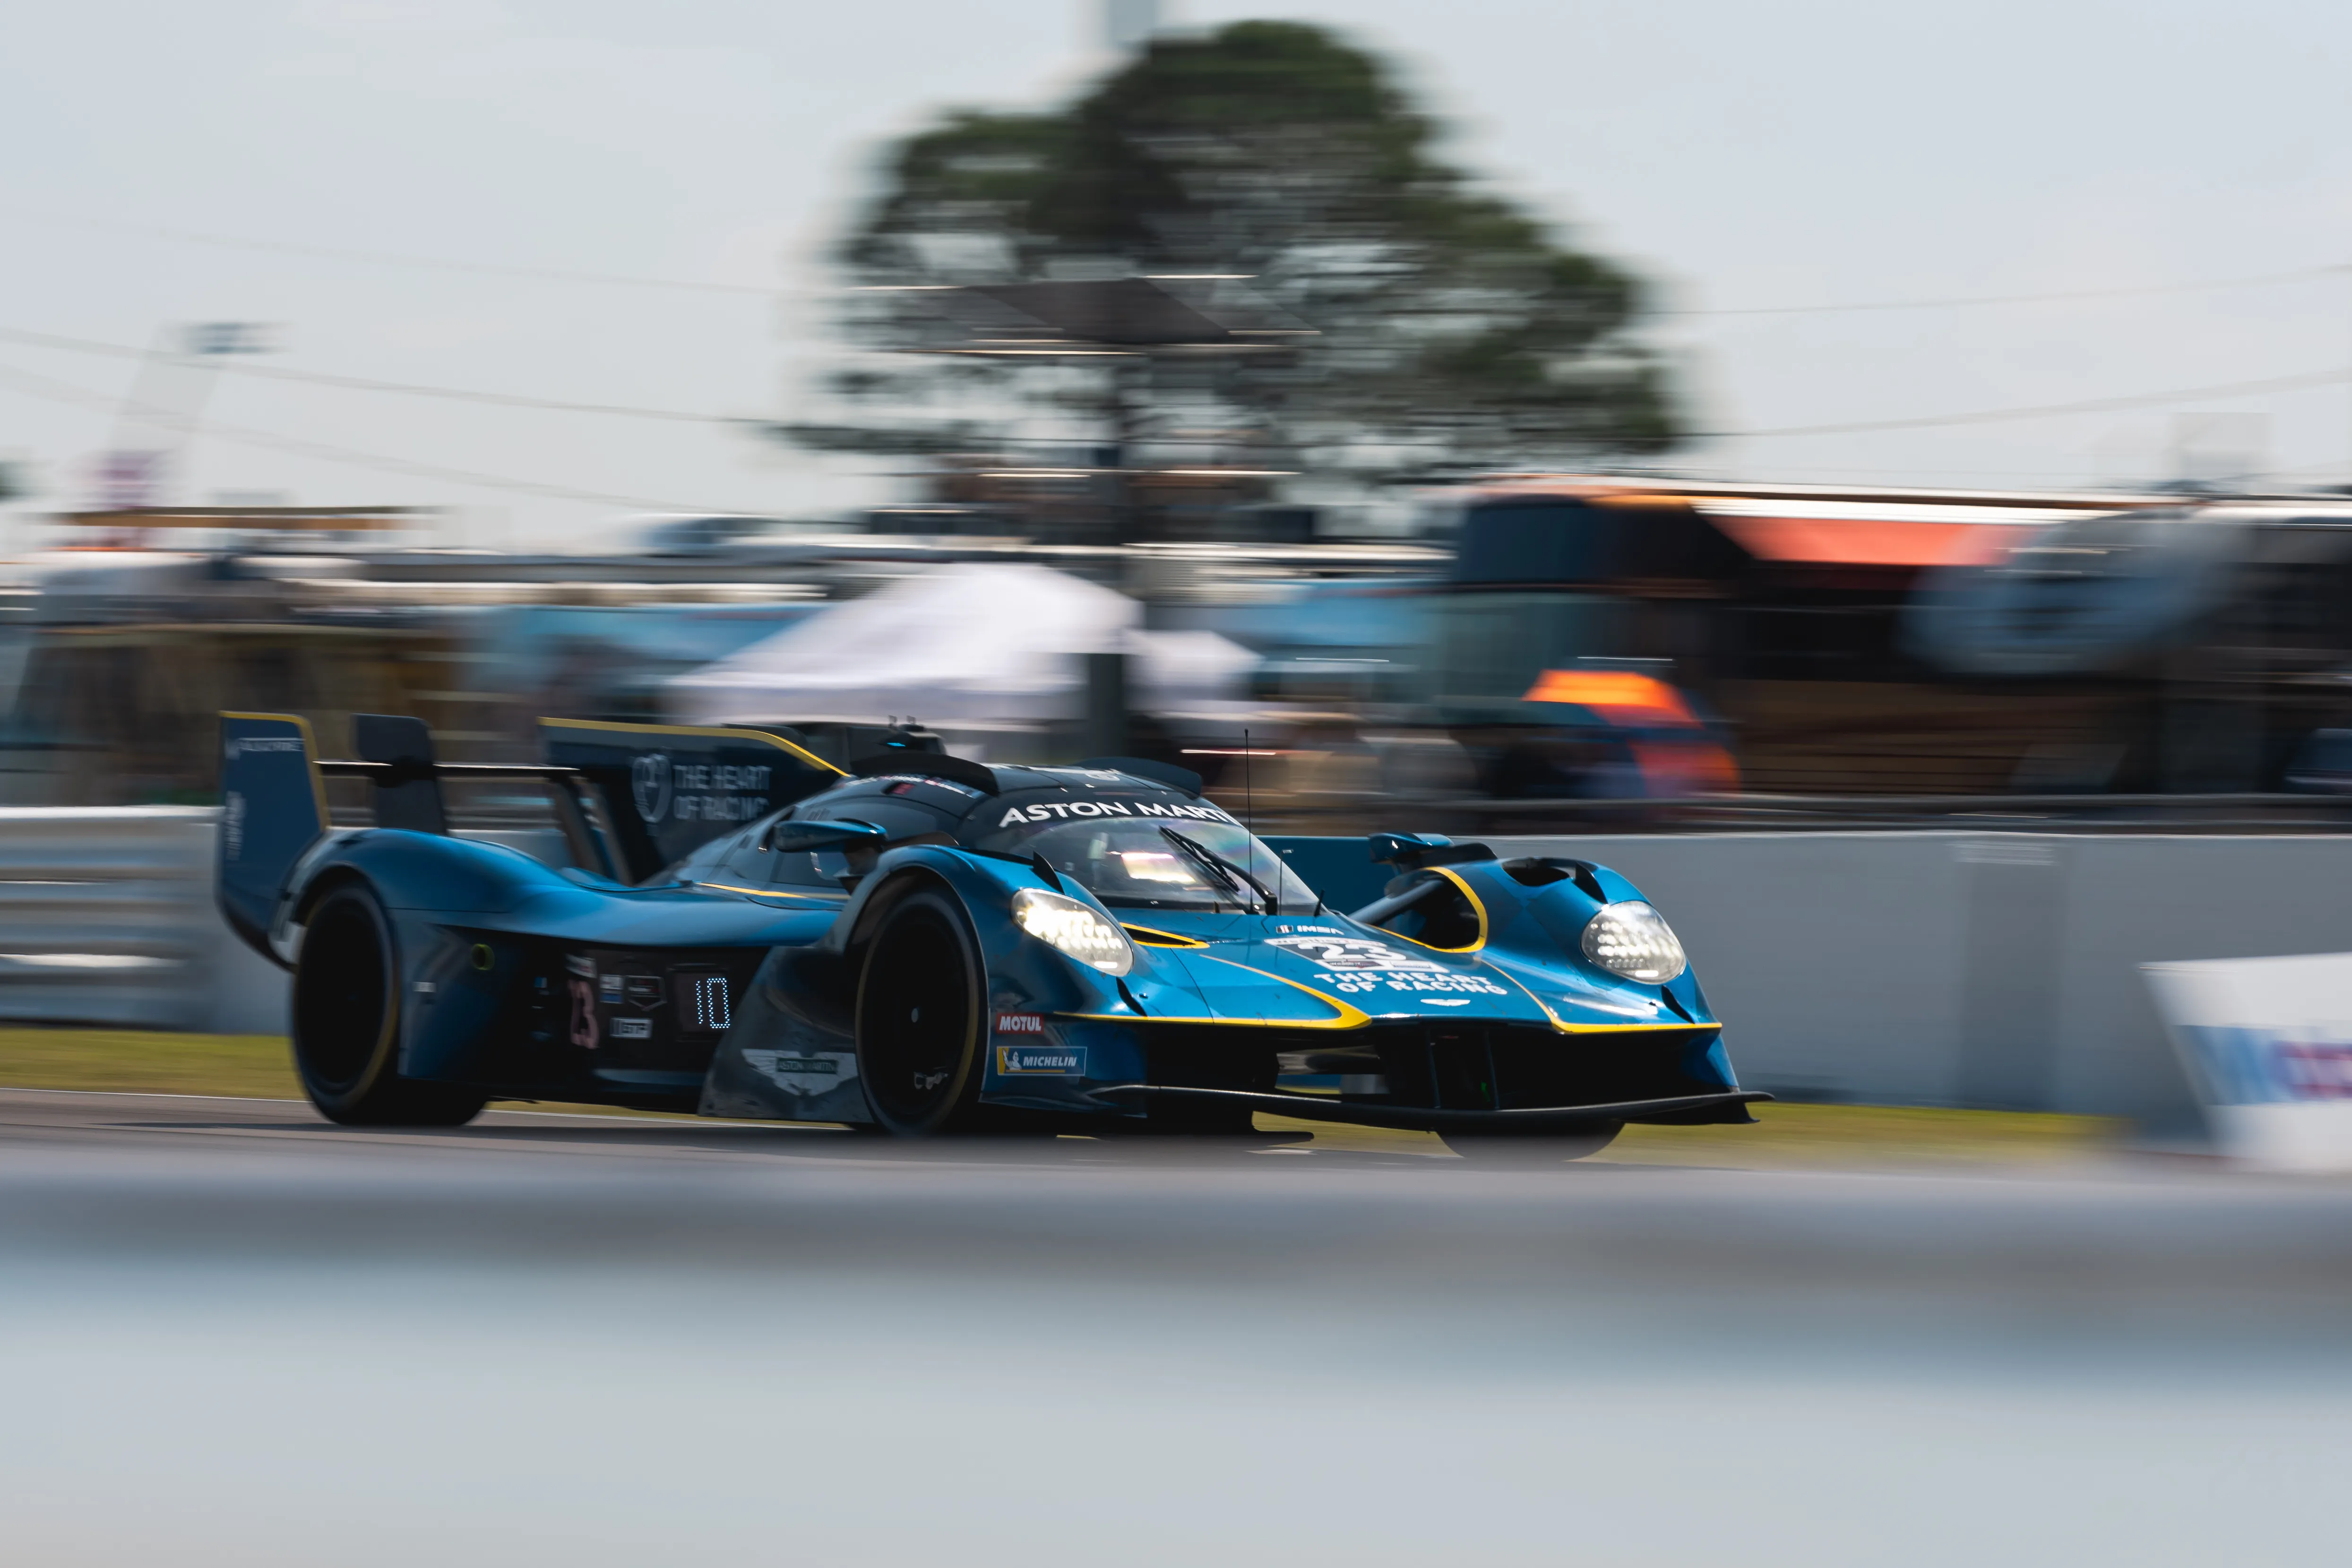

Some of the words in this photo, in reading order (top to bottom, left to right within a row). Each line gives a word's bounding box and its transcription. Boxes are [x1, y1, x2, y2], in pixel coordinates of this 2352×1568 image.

[999, 802, 1132, 828] ASTON
[1297, 943, 1406, 960] 23
[1313, 972, 1384, 983] THE
[1387, 972, 1492, 985] HEART
[1336, 981, 1376, 993] OF
[1386, 981, 1508, 995] RACING
[696, 977, 731, 1029] 10
[999, 1016, 1042, 1032] MOTUL
[1023, 1055, 1077, 1067] MICHELIN
